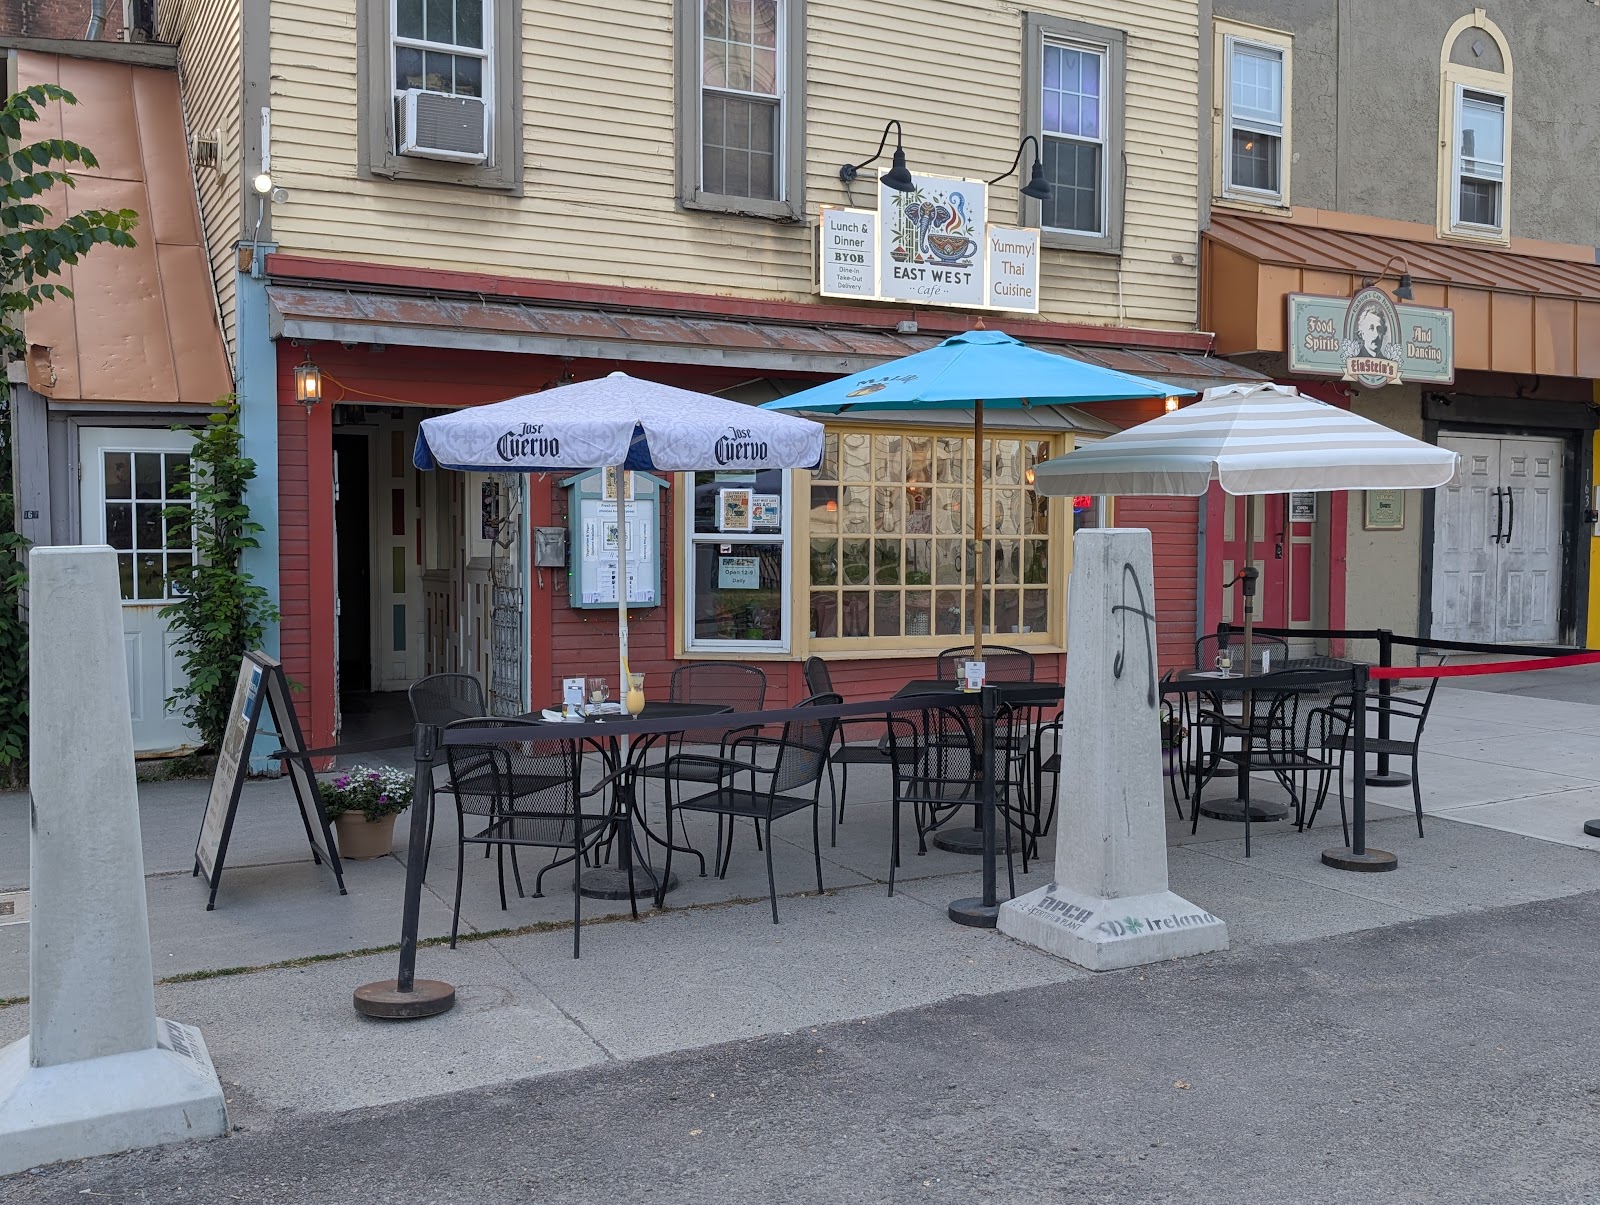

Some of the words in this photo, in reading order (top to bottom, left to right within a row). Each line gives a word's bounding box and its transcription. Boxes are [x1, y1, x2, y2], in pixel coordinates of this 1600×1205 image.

[830, 220, 859, 232] Lunch
[861, 224, 868, 234] &
[834, 235, 865, 247] Dinner
[992, 238, 1034, 258] Yummy!
[834, 252, 864, 263] BYOB
[894, 266, 926, 281] EAST
[932, 270, 972, 285] WEST
[1002, 261, 1024, 276] Thai
[838, 282, 862, 291] Delivery
[917, 285, 942, 298] Café
[994, 281, 1032, 298] Cuisine
[1306, 316, 1336, 336] Food,
[1304, 334, 1339, 353] Spirits
[1412, 326, 1432, 344] And
[1406, 342, 1442, 364] Dancing
[517, 422, 544, 438] Jose
[728, 426, 751, 442] Jose
[496, 430, 560, 462] Cuervo
[714, 435, 768, 466] Cuervo
[1060, 918, 1082, 930] PLANT
[1145, 913, 1216, 932] Ireland
